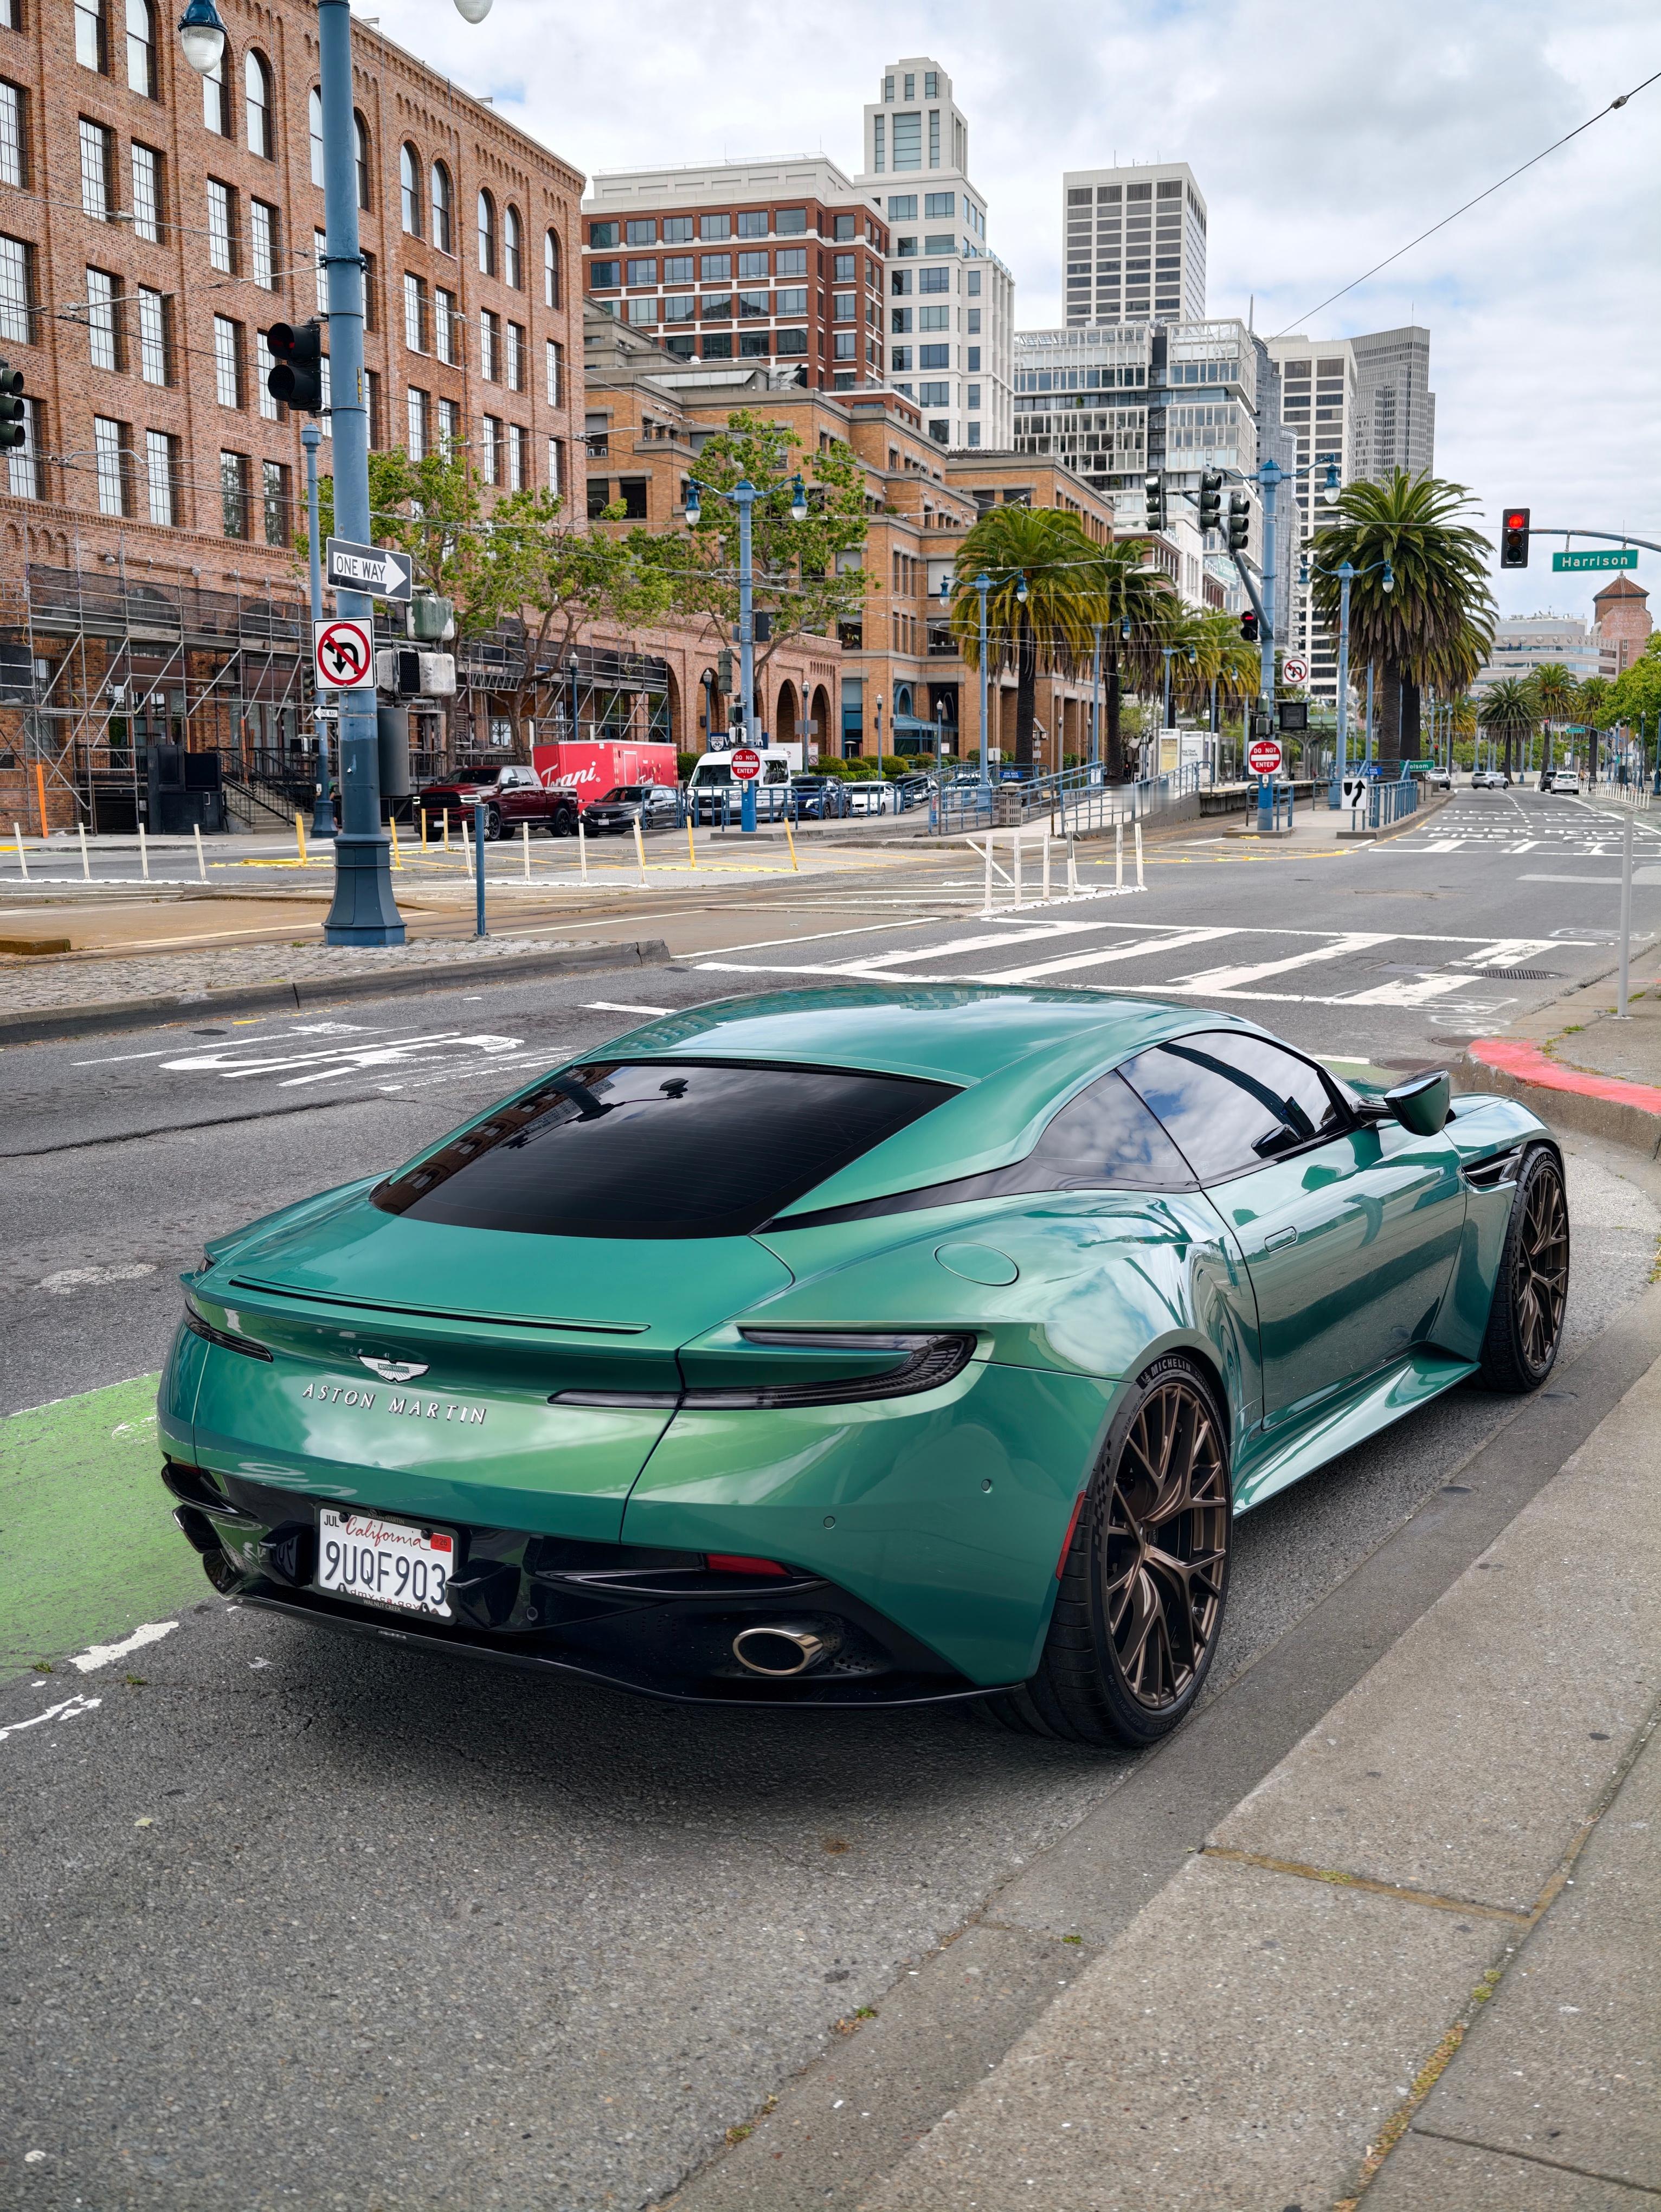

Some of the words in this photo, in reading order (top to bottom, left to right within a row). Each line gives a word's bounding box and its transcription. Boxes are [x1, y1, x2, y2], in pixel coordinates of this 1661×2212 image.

[337, 555, 358, 576] ONE
[362, 561, 386, 582] WAY
[1562, 556, 1628, 567] Harrison
[1150, 1359, 1192, 1377] MICHELIN
[302, 1383, 376, 1410] ASTON
[388, 1398, 487, 1425] MARTIN
[385, 1516, 405, 1525] MARTIN
[324, 1514, 340, 1528] JUL
[345, 1516, 431, 1551] California
[440, 1538, 448, 1546] 26
[325, 1540, 446, 1605] 9UQF903
[350, 1589, 420, 1610] dmv.ca.gov
[363, 1598, 384, 1608] WALNUT
[385, 1604, 402, 1613] CREEK
